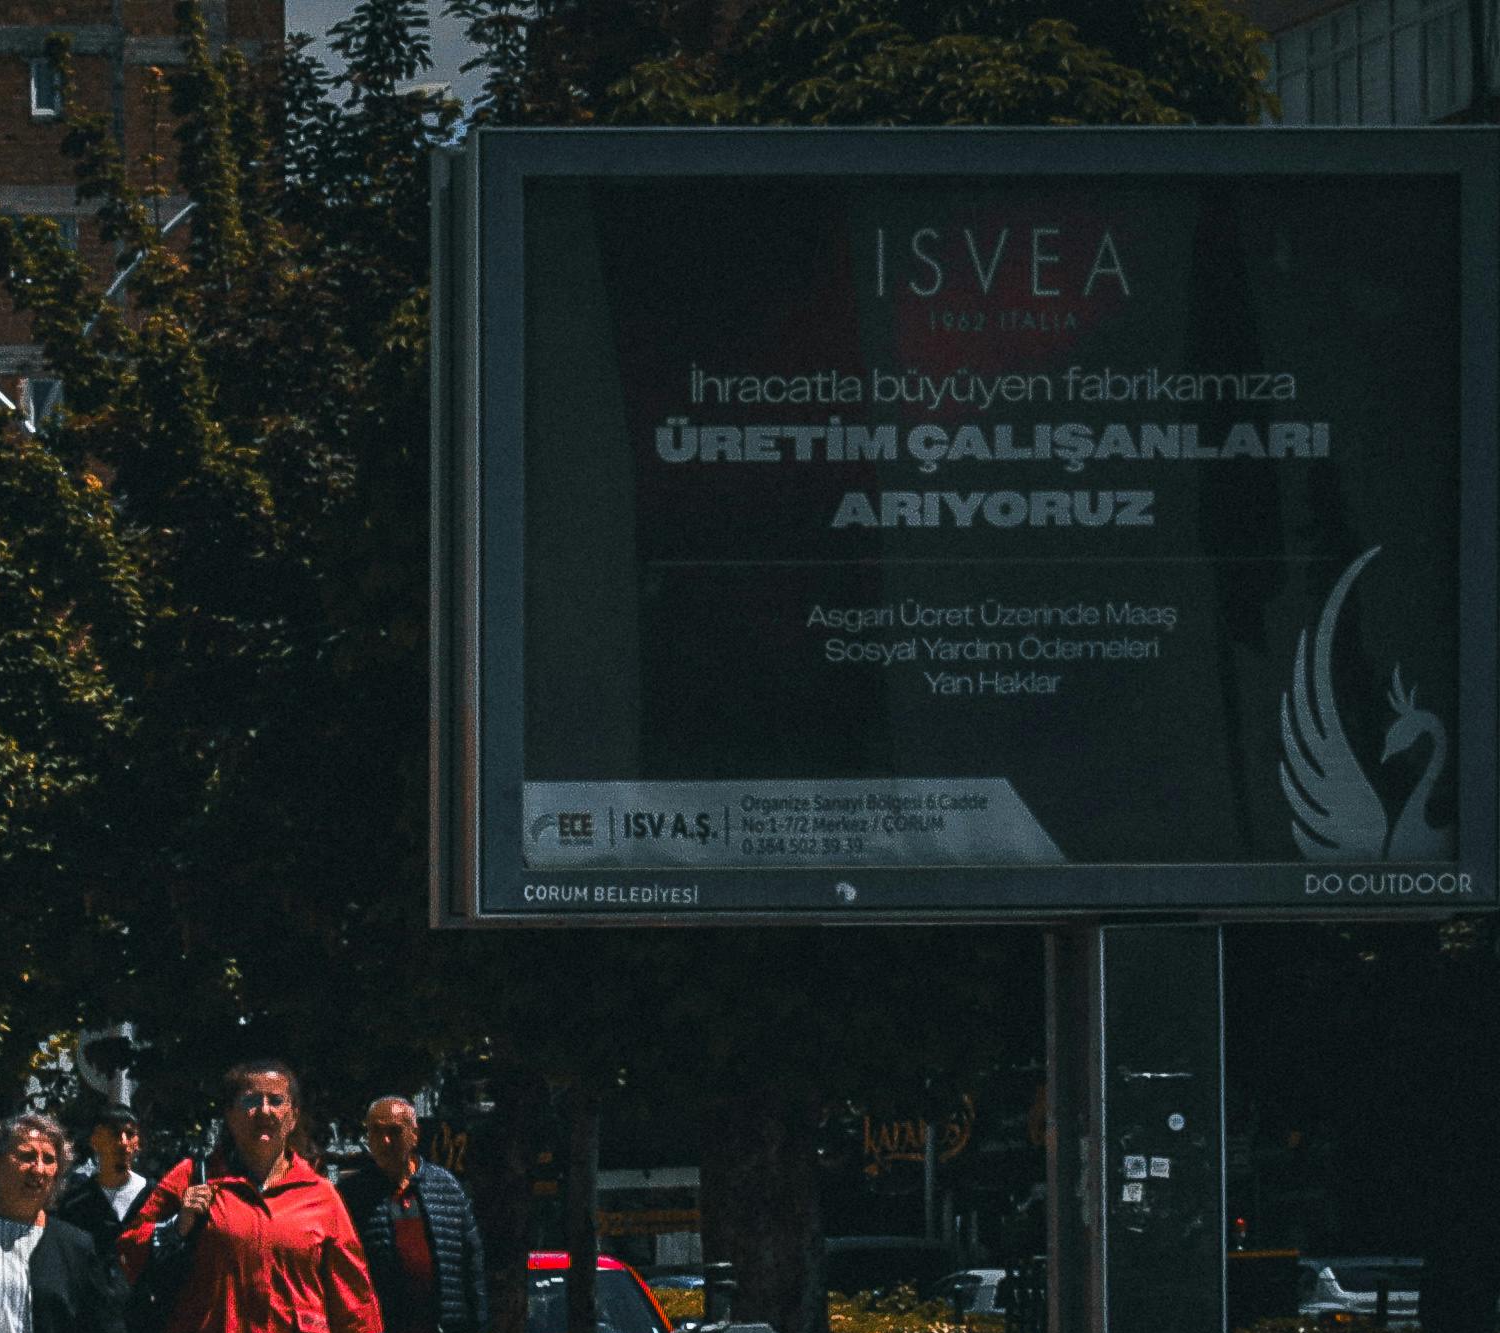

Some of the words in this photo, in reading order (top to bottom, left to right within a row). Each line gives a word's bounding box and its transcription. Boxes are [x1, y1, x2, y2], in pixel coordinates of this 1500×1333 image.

[876, 227, 1131, 297] ISVEA
[1000, 309, 1078, 332] ITALIA
[689, 362, 863, 404] İhracatla
[872, 366, 1053, 410] büyüyen
[1061, 365, 1297, 401] fabrikamıza
[655, 415, 898, 464] ÜRETİM
[906, 420, 1331, 473] ÇALIŞANLARI
[829, 490, 1156, 529] ARIYORUZ
[805, 603, 894, 634] Asgari
[900, 598, 975, 627] Ücret
[979, 598, 1100, 627] Üzerinde
[1106, 603, 1178, 631] Maaş
[824, 636, 917, 667] Sosyal
[922, 635, 1013, 662] Yardım
[1017, 632, 1160, 661] Ödemeleri
[924, 671, 975, 695] Yan
[978, 670, 1062, 695] Haklar
[624, 812, 665, 839] ISV
[671, 812, 719, 845] A.Ş.
[594, 883, 700, 905] BELEDİYESİ
[1305, 873, 1344, 895] DO
[1347, 873, 1473, 895] OUTDOOR
